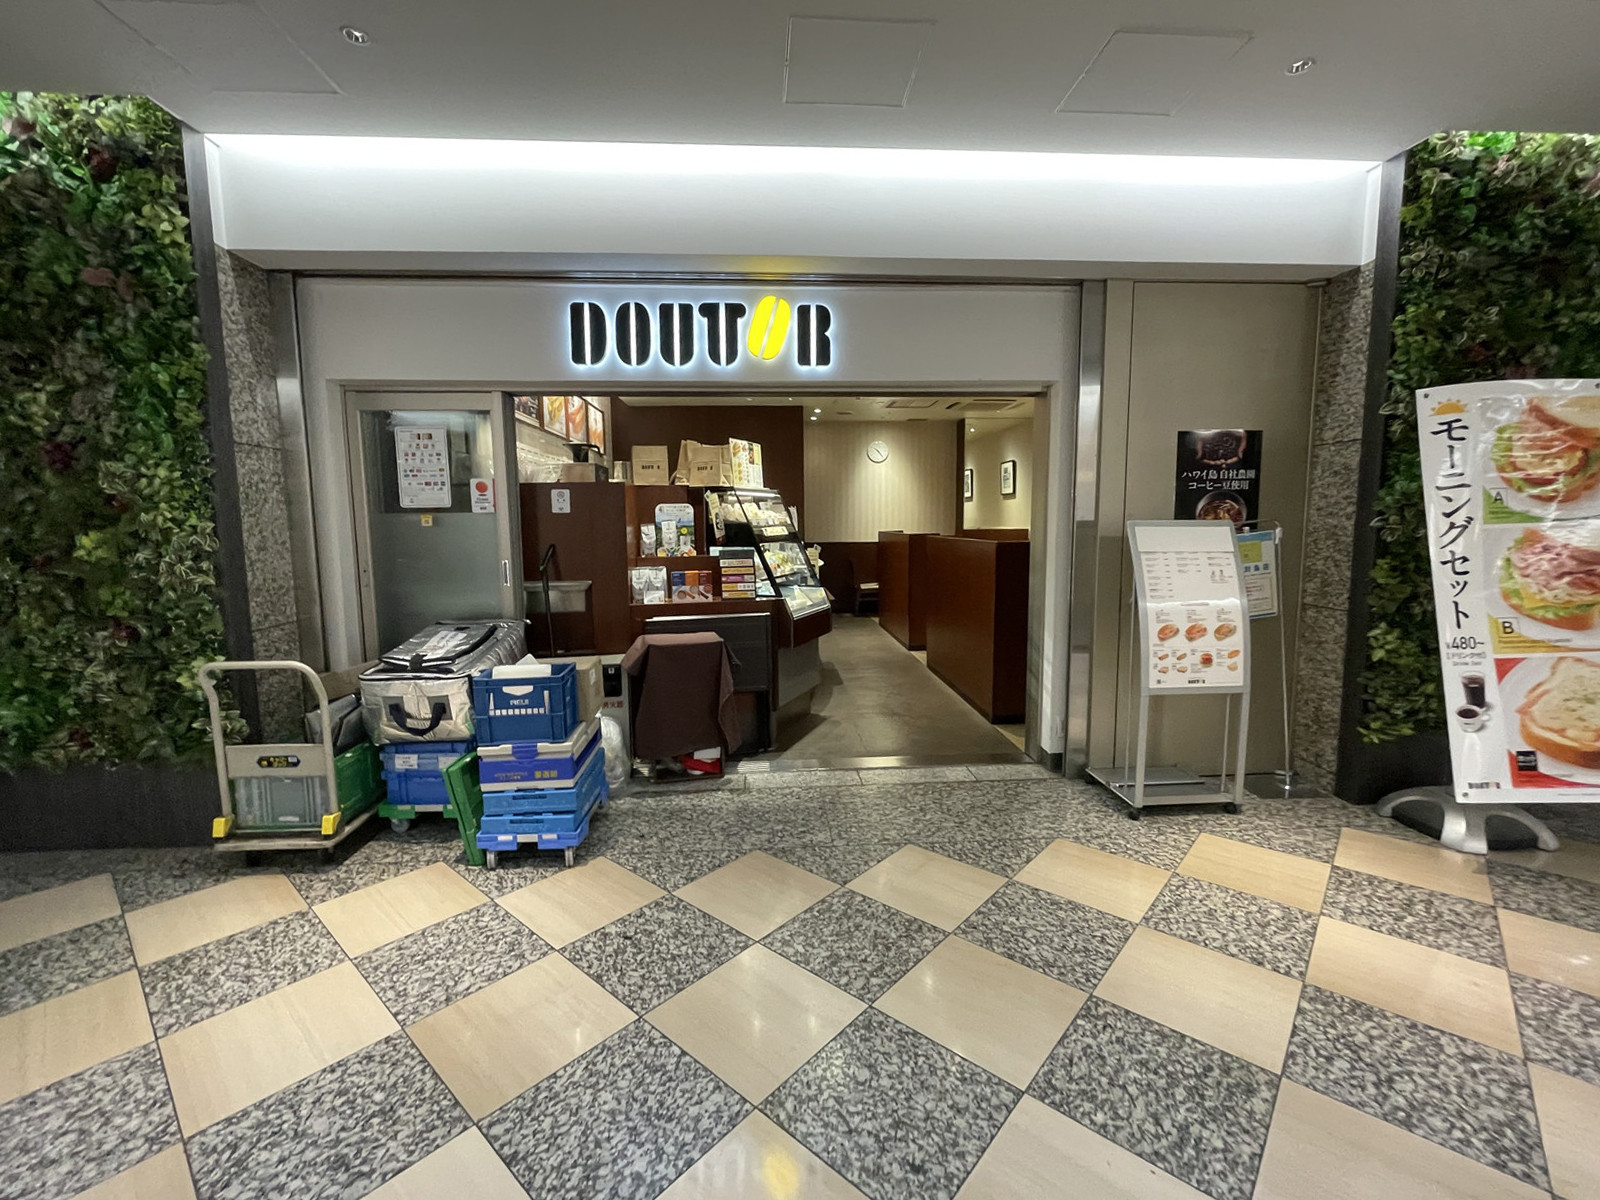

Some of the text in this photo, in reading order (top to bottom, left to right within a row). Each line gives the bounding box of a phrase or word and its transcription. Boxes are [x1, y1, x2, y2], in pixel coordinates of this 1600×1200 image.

[569, 295, 832, 367] DOUTOR
[1181, 469, 1218, 480] ハワイ島
[1188, 480, 1249, 490] コーヒー豆使用
[1493, 491, 1504, 504] A
[1431, 418, 1474, 629] モーニングセット
[1502, 622, 1514, 634] B
